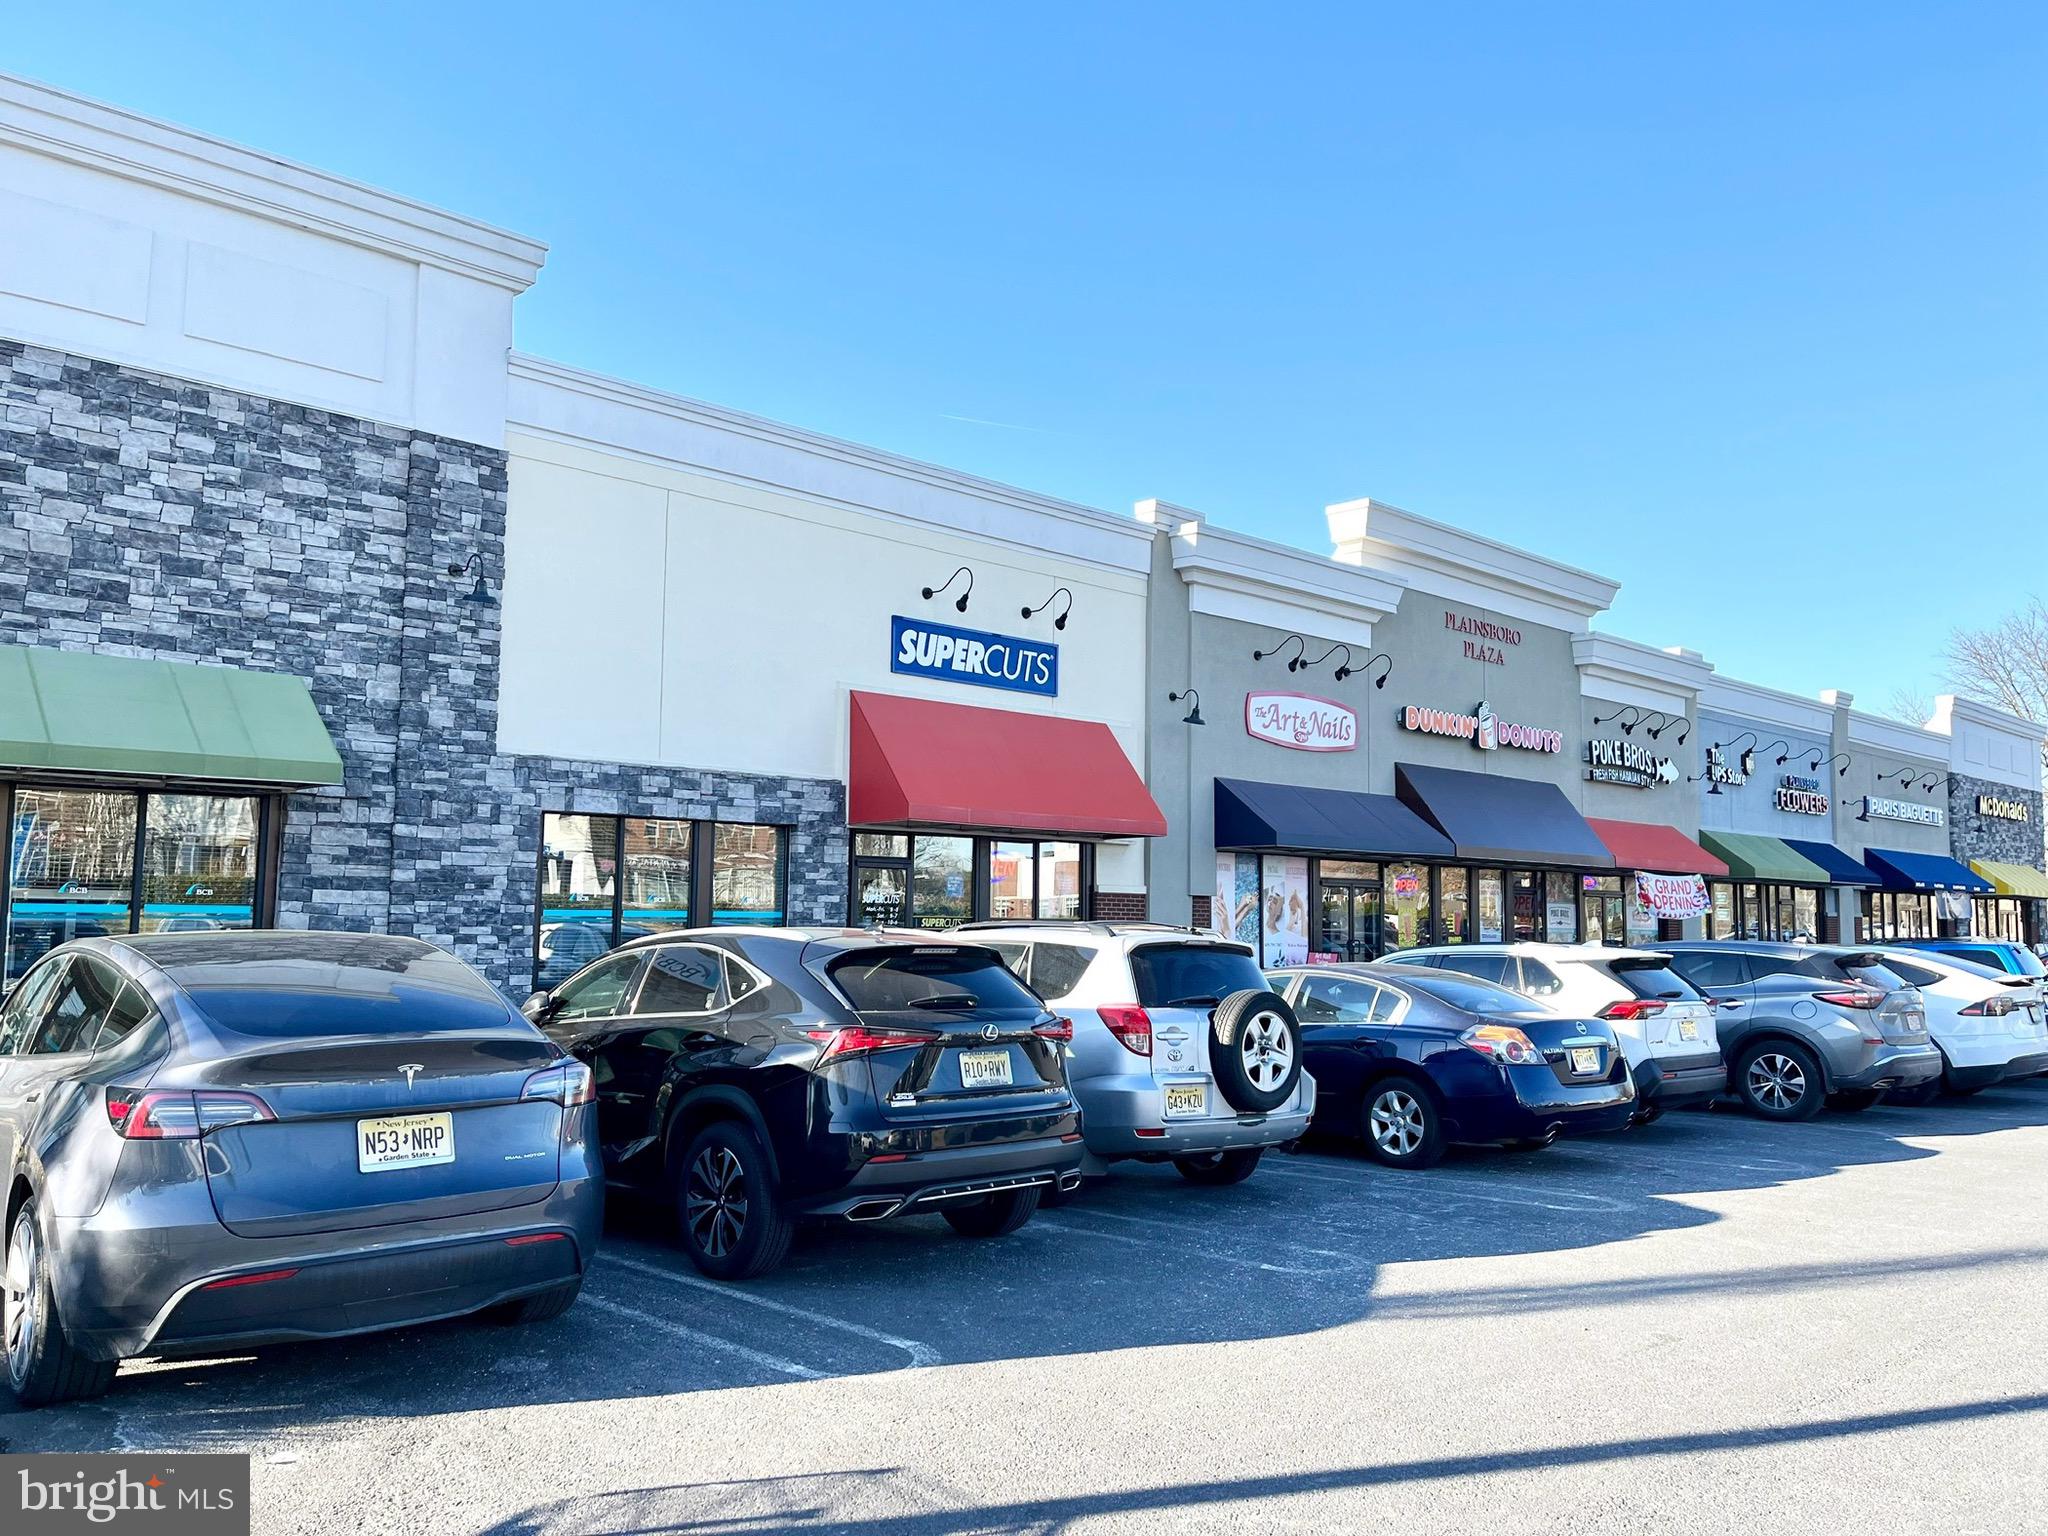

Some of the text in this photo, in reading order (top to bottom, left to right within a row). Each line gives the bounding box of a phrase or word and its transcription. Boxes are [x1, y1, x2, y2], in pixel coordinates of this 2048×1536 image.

[1444, 611, 1522, 647] PLAINSBORO
[898, 628, 1051, 685] SUPERCUTS
[1463, 640, 1505, 666] PLAZA
[1254, 706, 1267, 718] The
[1262, 703, 1299, 733] Art
[1307, 711, 1351, 741] Nails
[1405, 705, 1562, 754] DUNKIN' DONUTS
[1592, 739, 1655, 775] POKE BROS.
[1711, 748, 1725, 765] The
[1640, 774, 1656, 789] STYLE
[1711, 765, 1727, 783] UPS
[1727, 767, 1747, 786] Store
[1777, 788, 1829, 815] FLOWERS
[1870, 798, 1944, 823] PARIS BAGUETTE
[874, 840, 891, 849] 201
[69, 886, 88, 894] BCB
[196, 888, 214, 896] BCB
[1394, 879, 1419, 891] OPEN
[1654, 879, 1692, 895] GRAND
[862, 895, 900, 904] SUPERCUTS
[1653, 893, 1701, 911] OPENING
[921, 918, 962, 928] SUPERCUTS
[1168, 1094, 1203, 1110] G43 KZU
[382, 1117, 428, 1129] New Jersey
[365, 1126, 445, 1155] N53 NRP
[384, 1151, 430, 1162] Garden State
